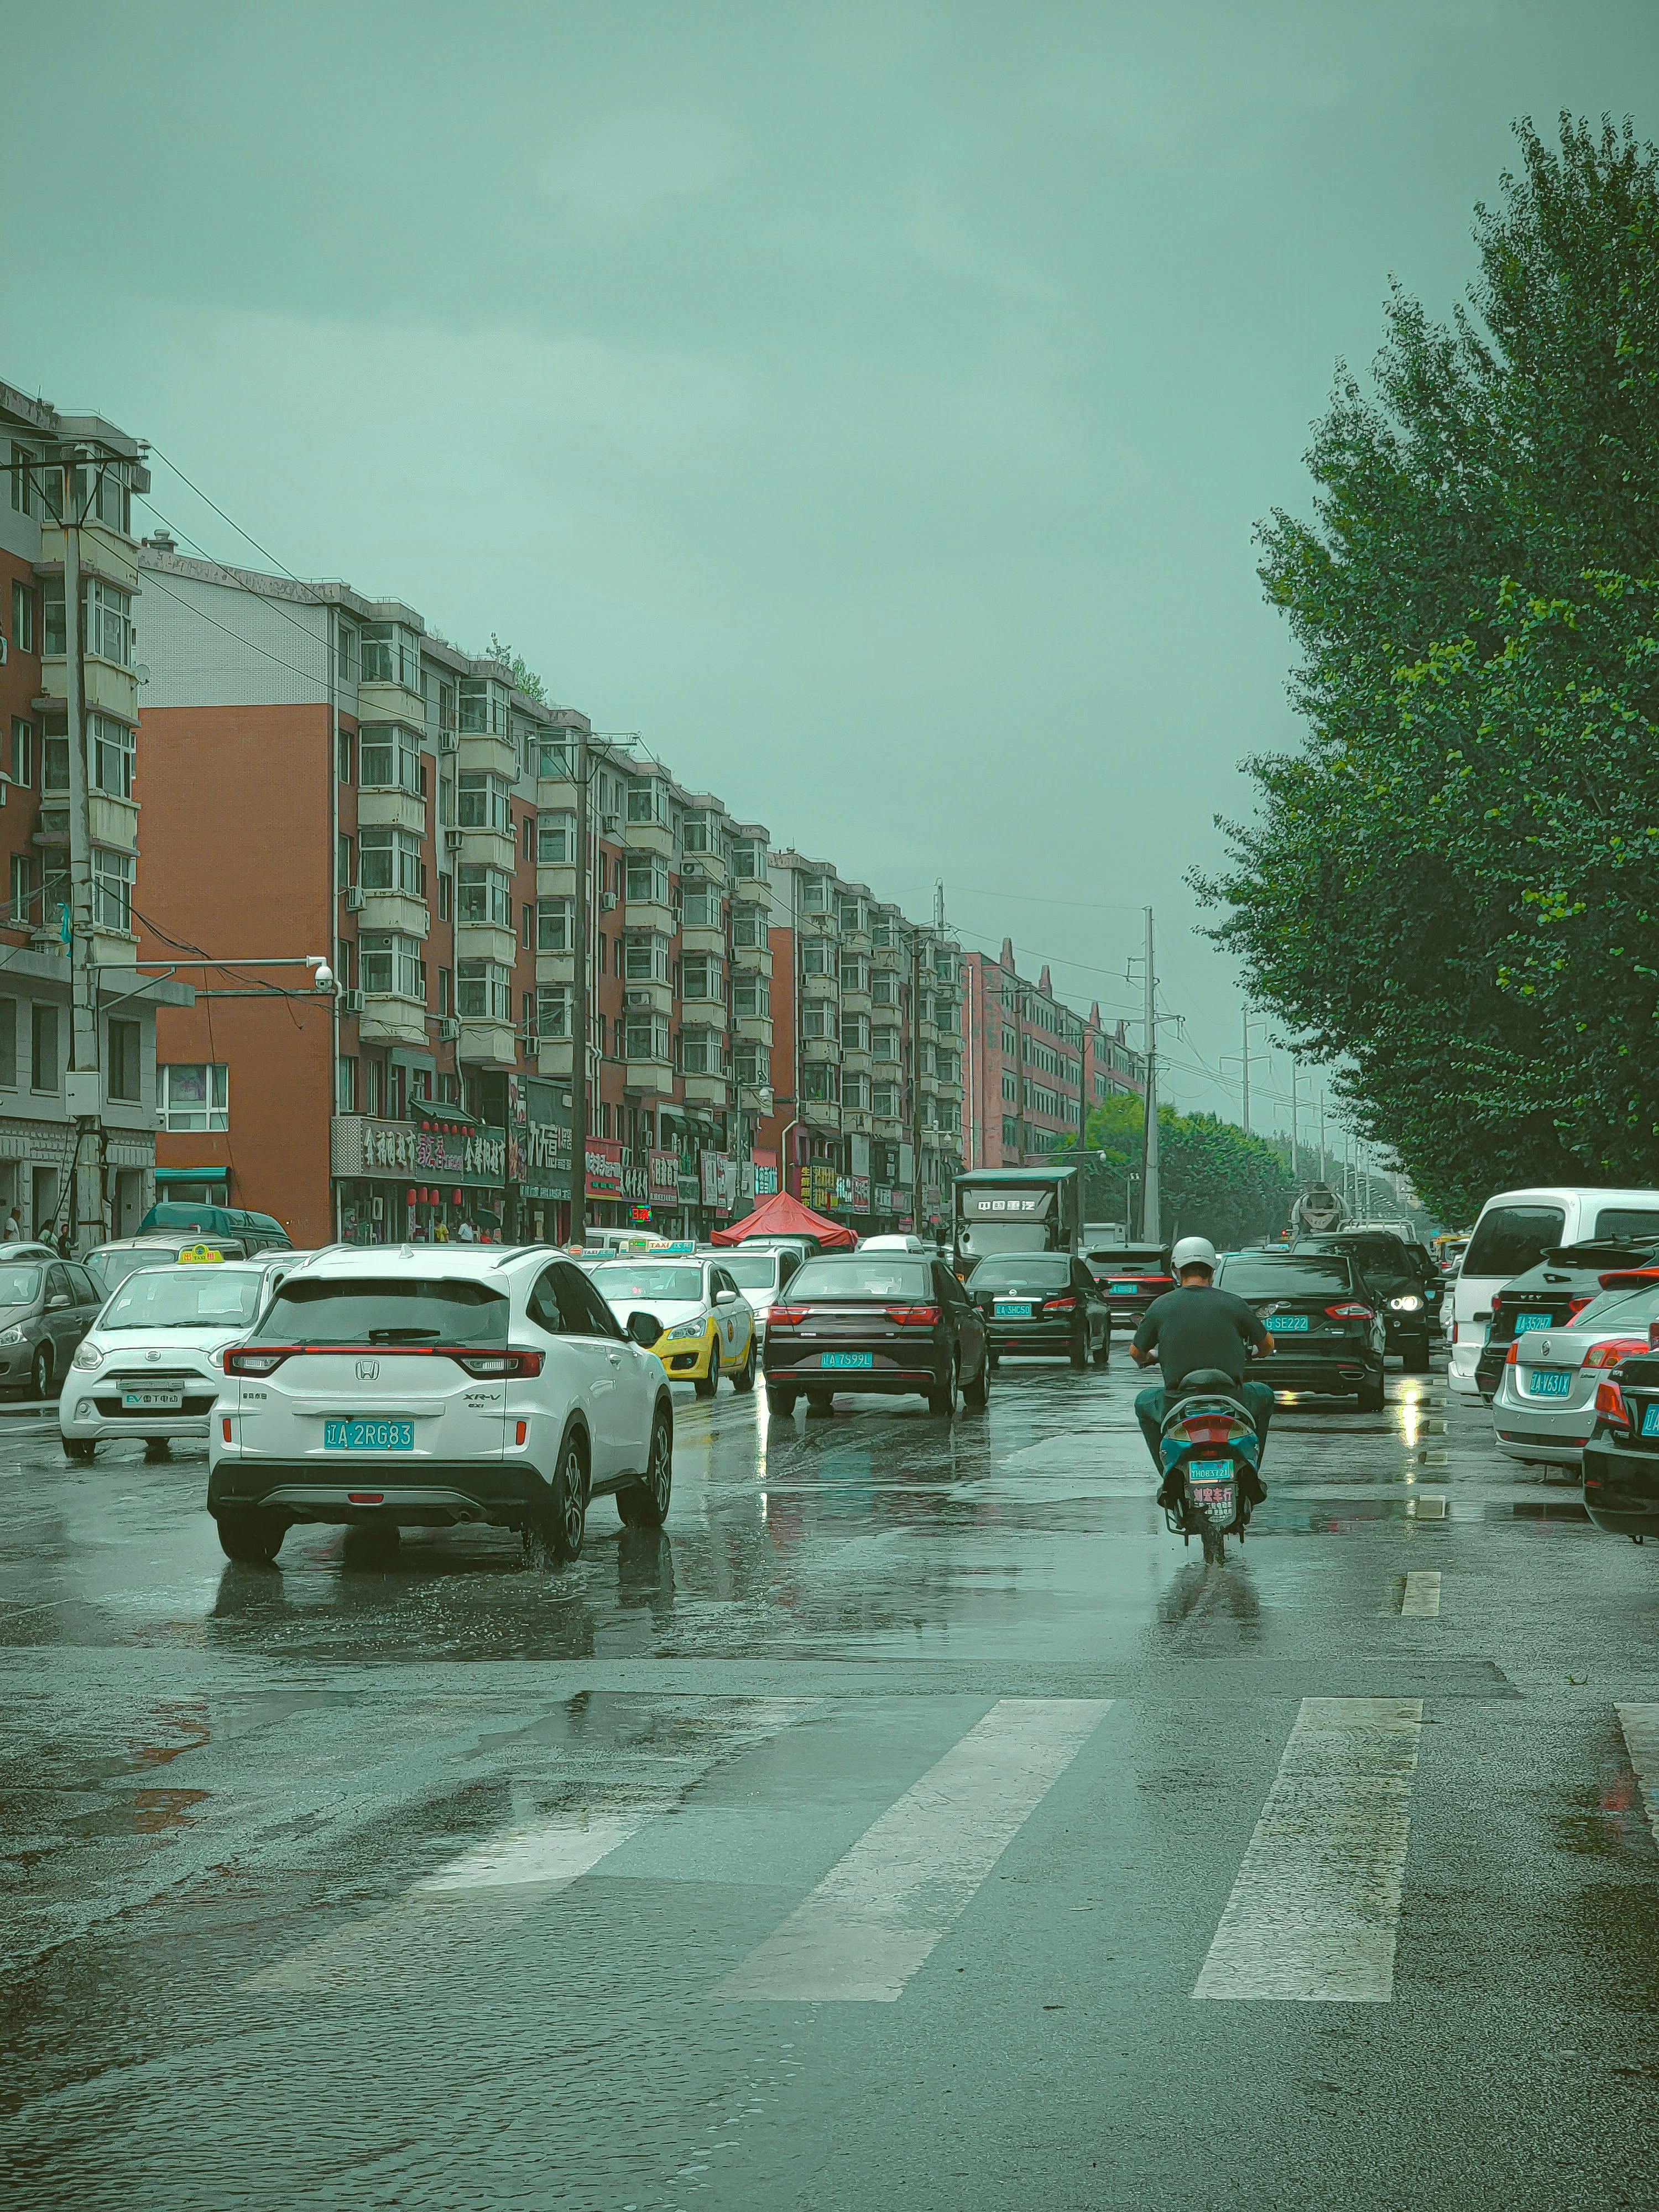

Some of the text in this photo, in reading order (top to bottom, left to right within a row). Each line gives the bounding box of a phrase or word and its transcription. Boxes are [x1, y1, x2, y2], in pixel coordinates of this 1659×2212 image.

[978, 1201, 1036, 1211] 中国重汽
[1261, 1317, 1306, 1329] G·SE222
